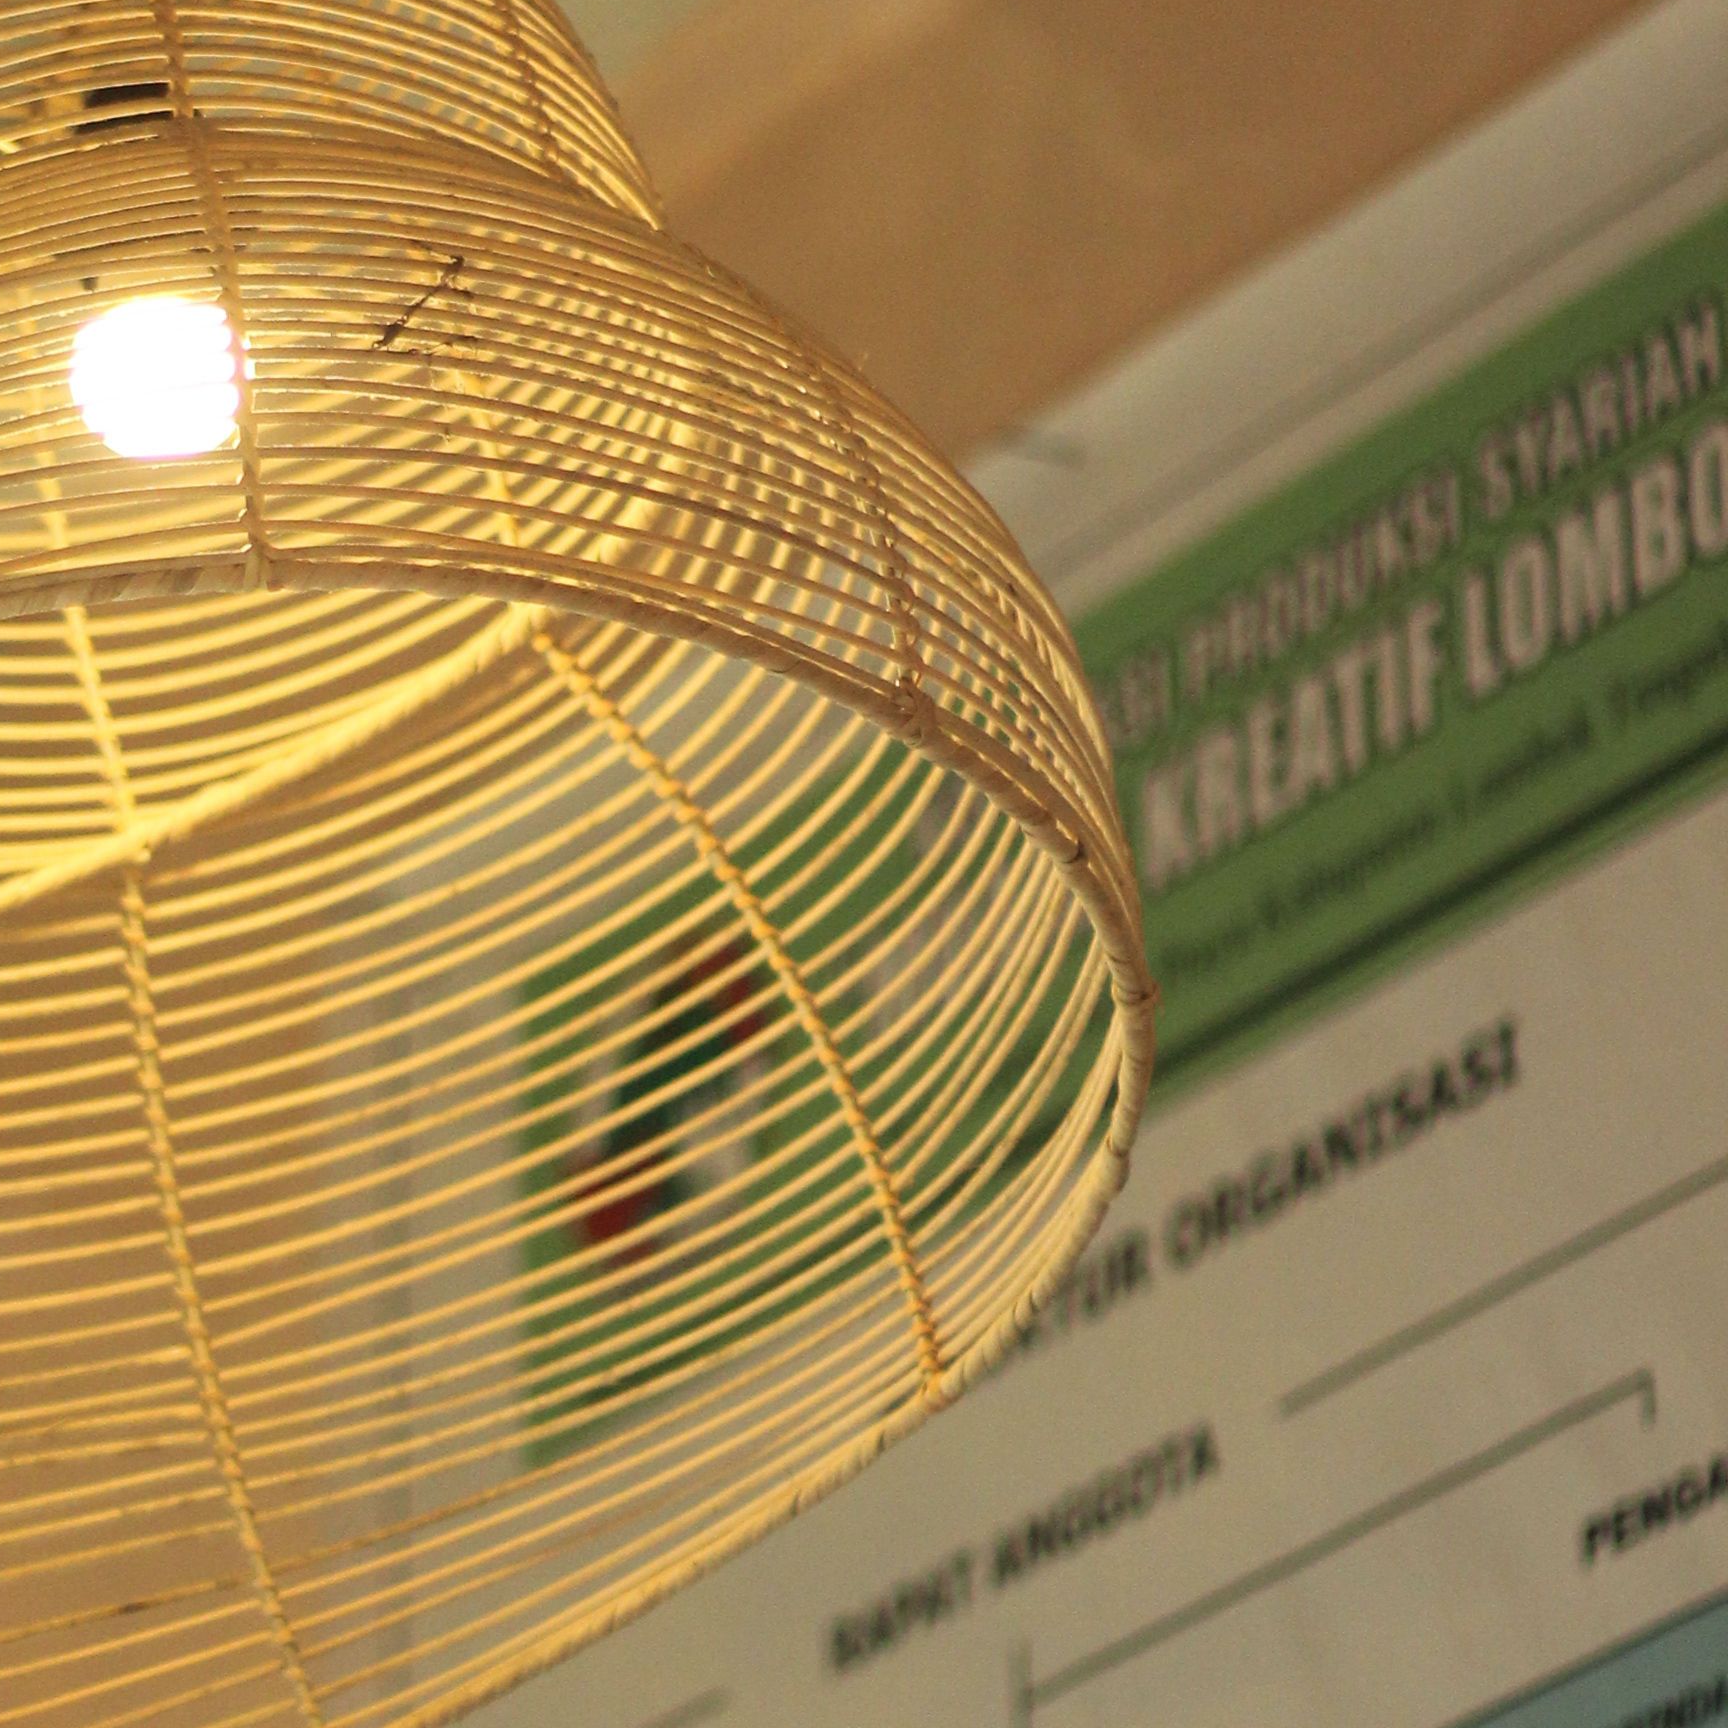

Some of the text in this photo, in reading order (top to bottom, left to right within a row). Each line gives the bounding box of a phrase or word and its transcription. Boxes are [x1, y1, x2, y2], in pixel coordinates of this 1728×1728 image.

[1478, 298, 1722, 521] SYARIAH
[1140, 598, 1442, 896] KREATIF
[1164, 1014, 1521, 1270] ORGANISASI
[989, 1422, 1221, 1588] ANGGOTA
